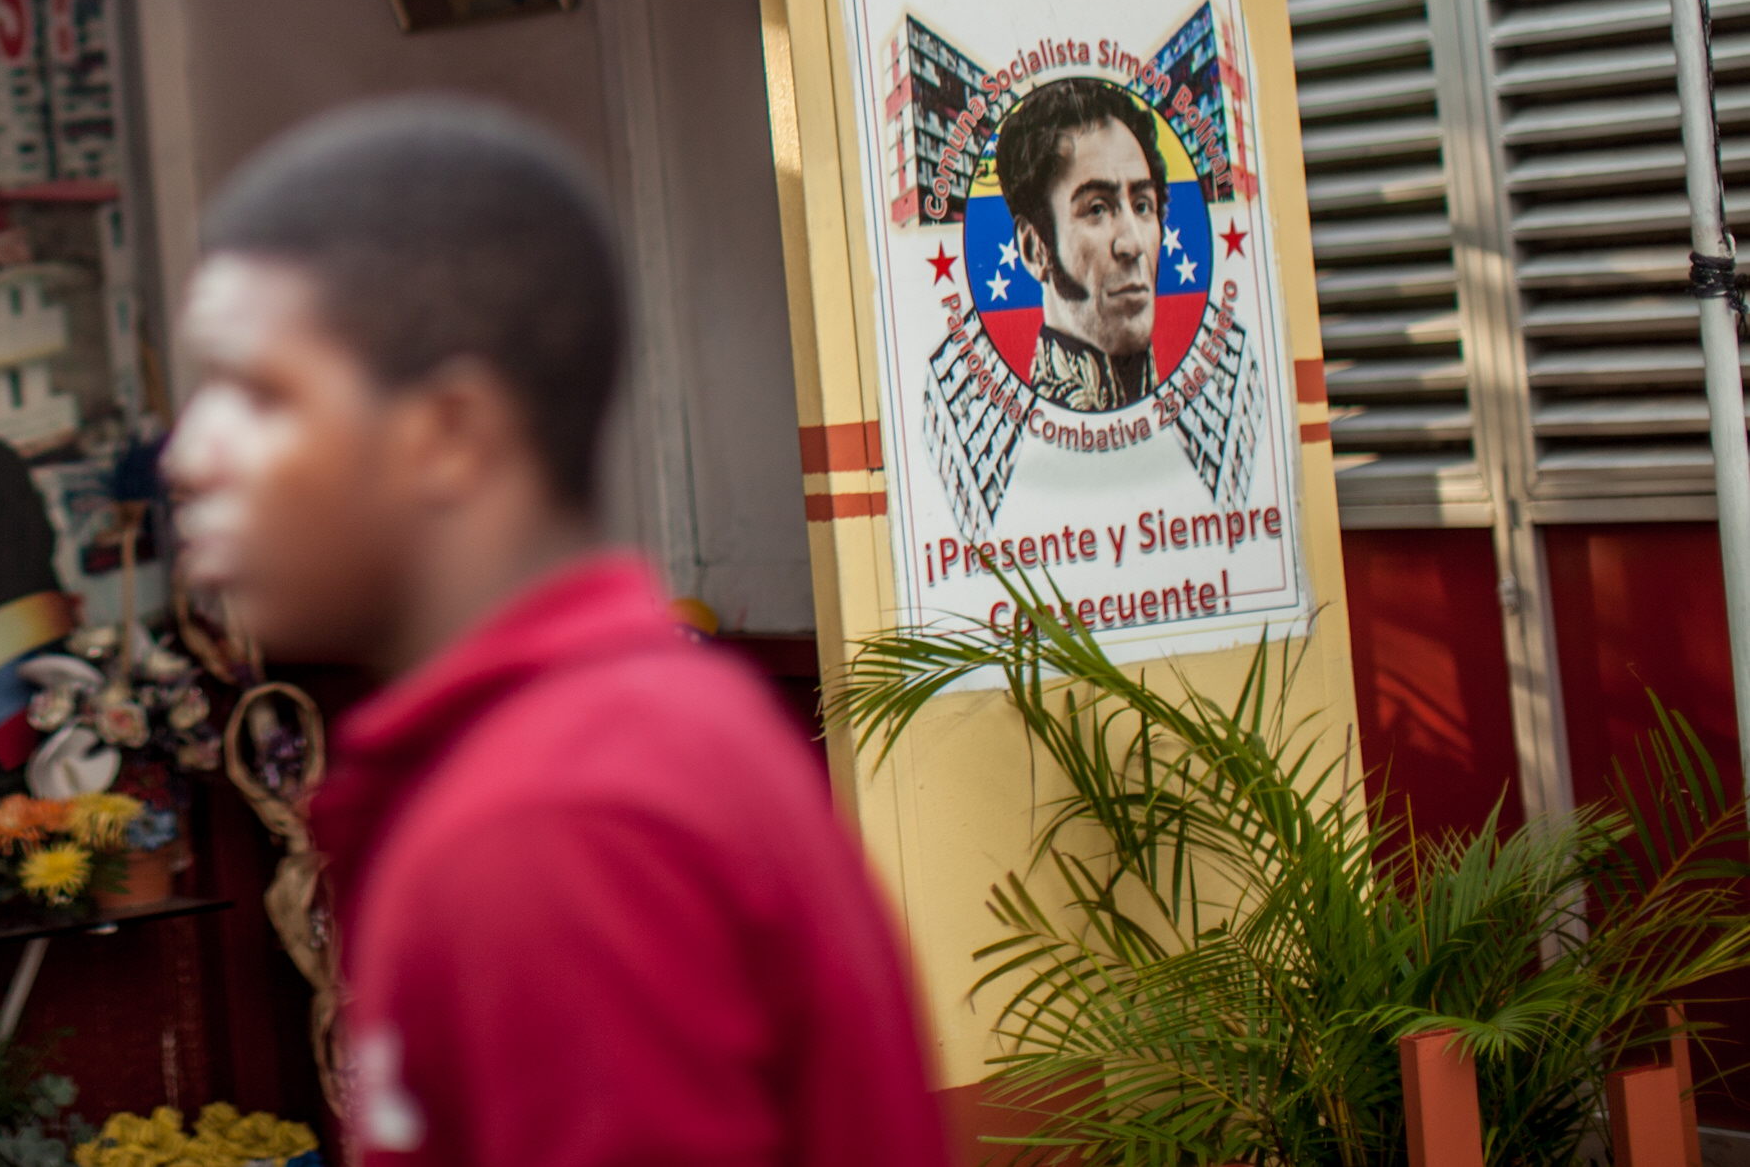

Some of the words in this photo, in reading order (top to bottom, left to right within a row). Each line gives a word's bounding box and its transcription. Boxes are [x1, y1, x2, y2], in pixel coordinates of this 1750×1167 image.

[925, 97, 987, 219] Comuna
[981, 37, 1090, 101] Socialista
[1097, 38, 1172, 98] Simón
[940, 292, 1024, 422] Parroquia
[1027, 408, 1152, 452] Combativa
[1152, 390, 1181, 427] 23
[1181, 366, 1208, 400] de
[1200, 279, 1238, 366] Enero
[924, 524, 1097, 585] ¡Presente
[1107, 523, 1127, 567] y
[1137, 505, 1283, 552] Siempre
